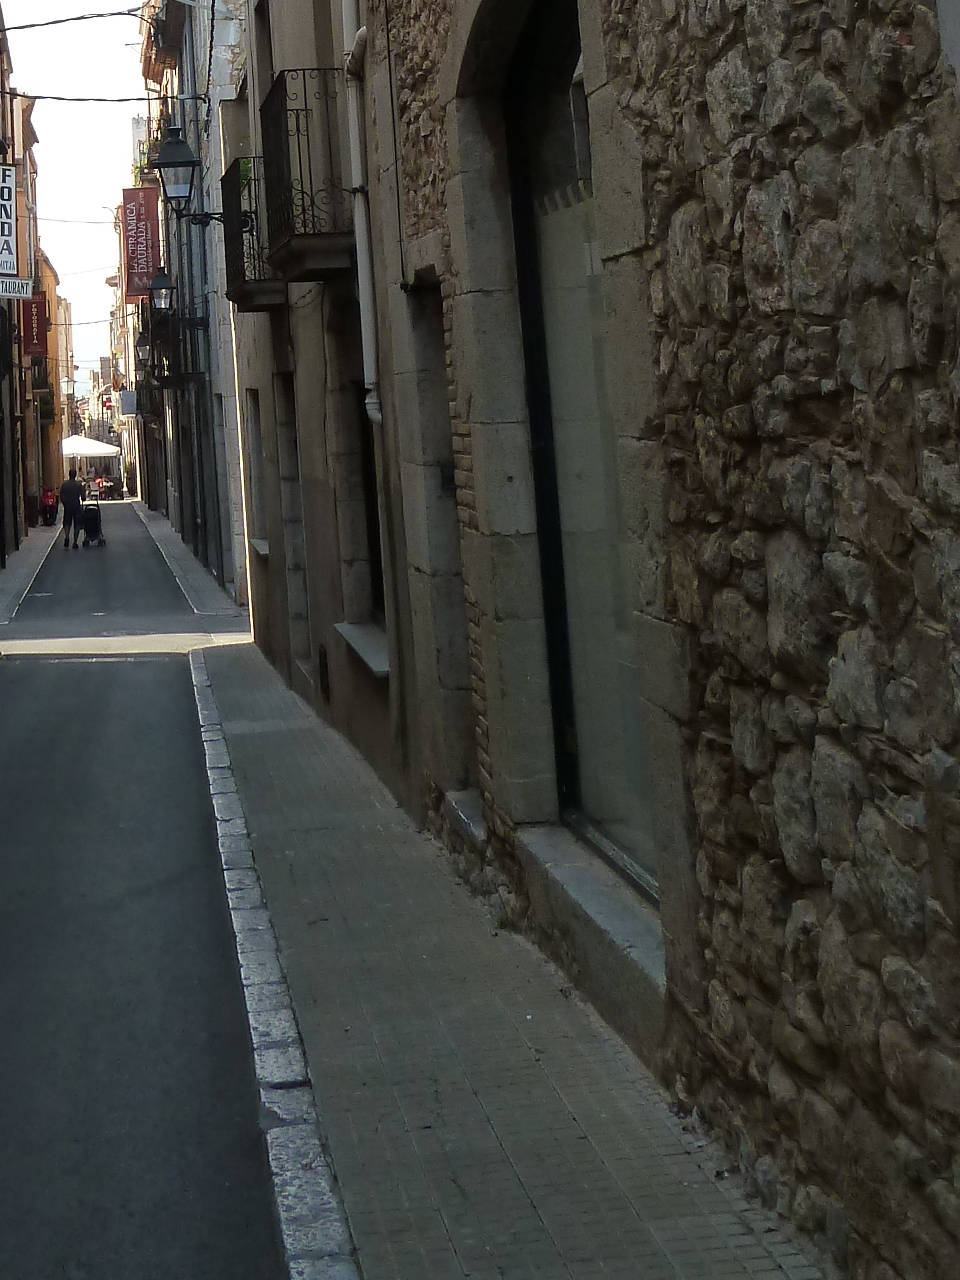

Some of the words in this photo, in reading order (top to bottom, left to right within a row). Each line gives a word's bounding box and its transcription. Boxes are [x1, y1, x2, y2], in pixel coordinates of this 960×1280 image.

[0, 168, 13, 255] FONDA
[137, 221, 147, 273] DAURADA
[0, 260, 15, 271] MITJA
[130, 259, 138, 273] LA
